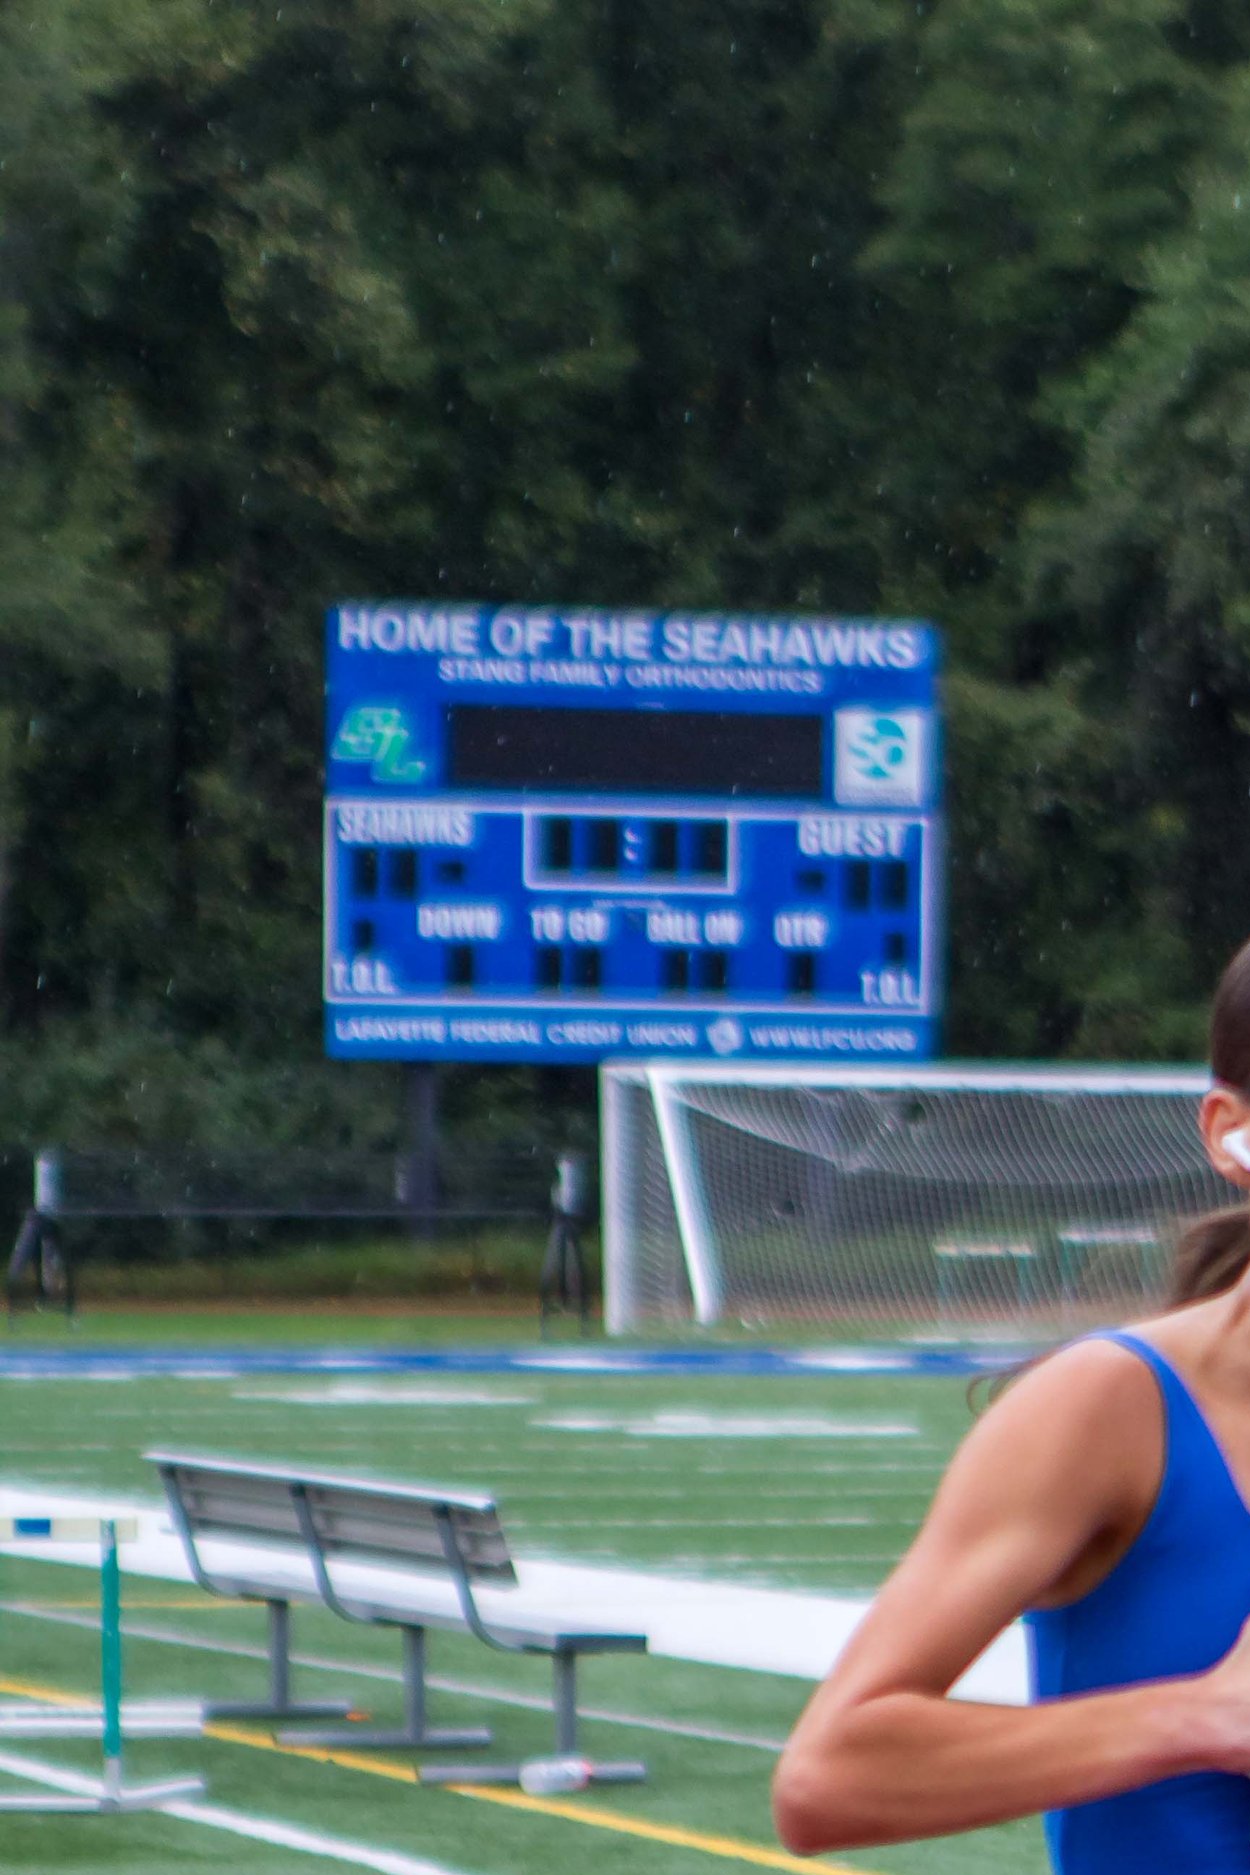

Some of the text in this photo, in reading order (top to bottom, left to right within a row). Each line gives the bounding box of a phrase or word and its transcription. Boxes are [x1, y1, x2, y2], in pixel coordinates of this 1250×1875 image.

[338, 607, 916, 669] HOME OF THE SEAHAWKS
[529, 661, 619, 688] FAMILY
[624, 663, 823, 693] ORTHODONTICS
[799, 816, 903, 857] GUEST
[418, 904, 498, 939] DOWN
[531, 908, 606, 942] TO GO
[626, 1022, 696, 1047] UNION
